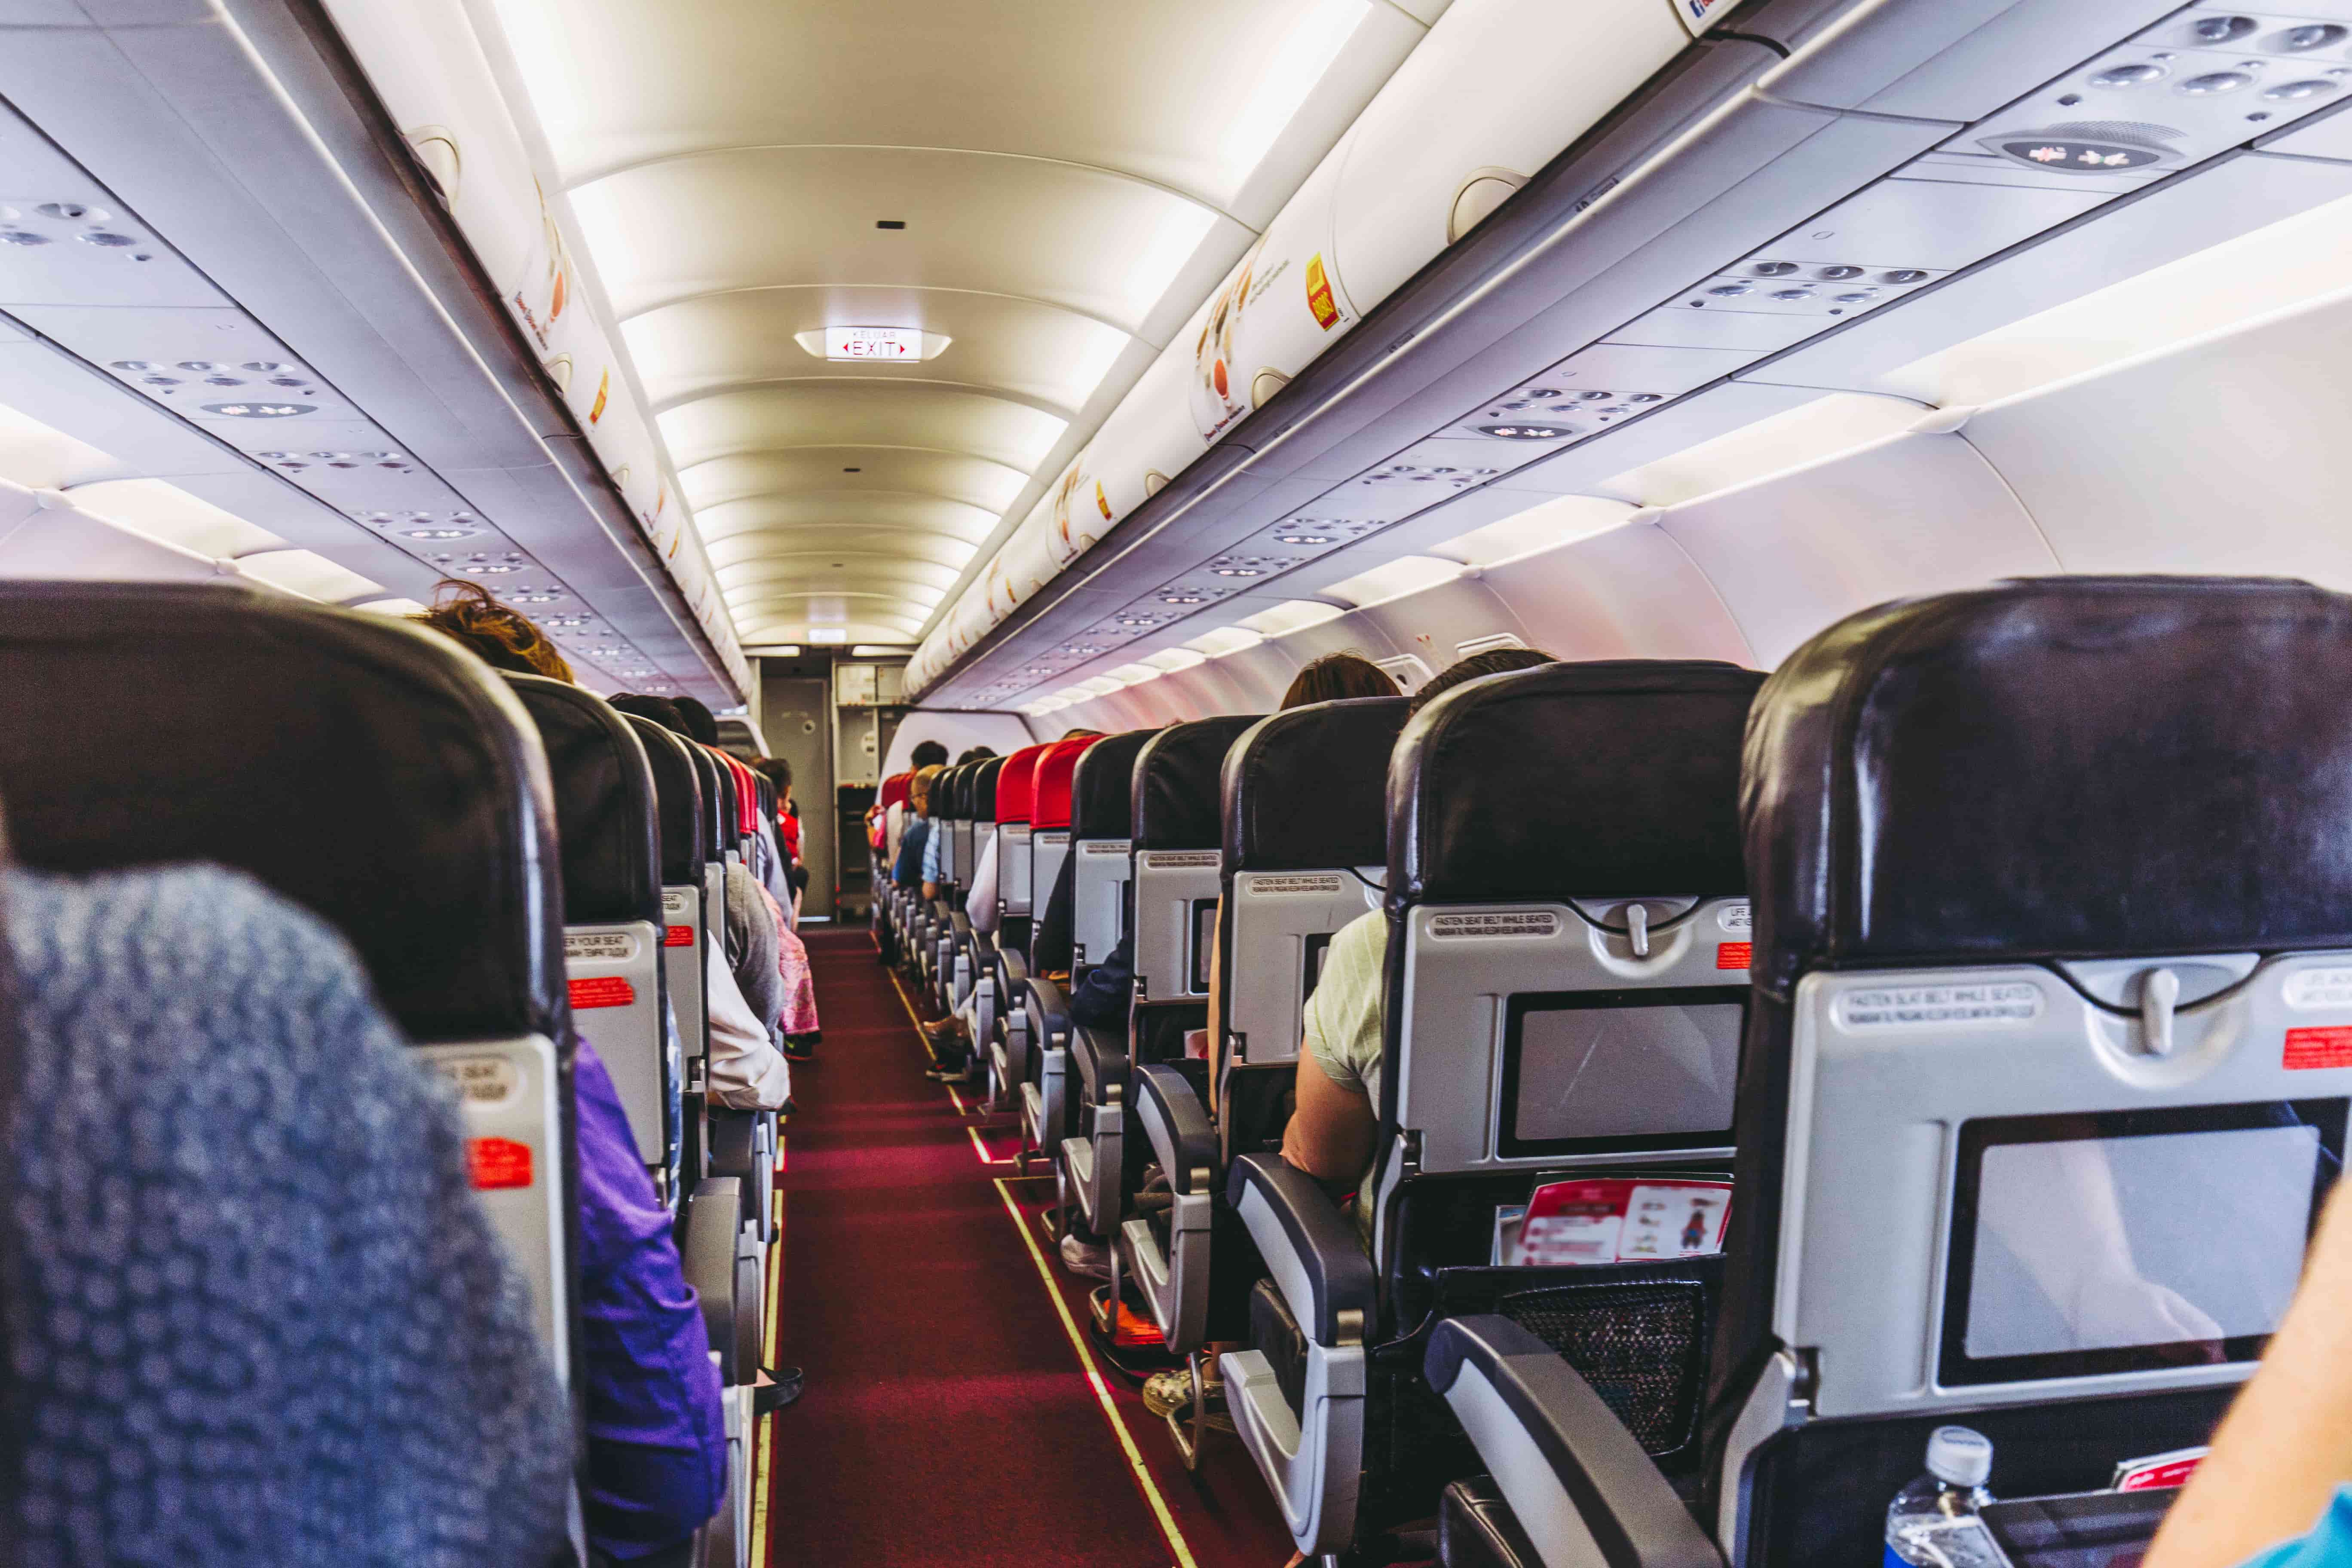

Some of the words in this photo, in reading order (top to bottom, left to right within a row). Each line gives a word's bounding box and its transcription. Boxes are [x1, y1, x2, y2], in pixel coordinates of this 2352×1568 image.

[853, 341, 896, 356] EXIT
[1435, 917, 1462, 925] FASTEN
[1464, 916, 1482, 925] SEAT
[1483, 916, 1501, 925] BELT
[1502, 915, 1524, 924] WHILE
[1525, 914, 1553, 924] SEATED
[578, 937, 600, 946] YOUR
[603, 936, 623, 945] SEAT
